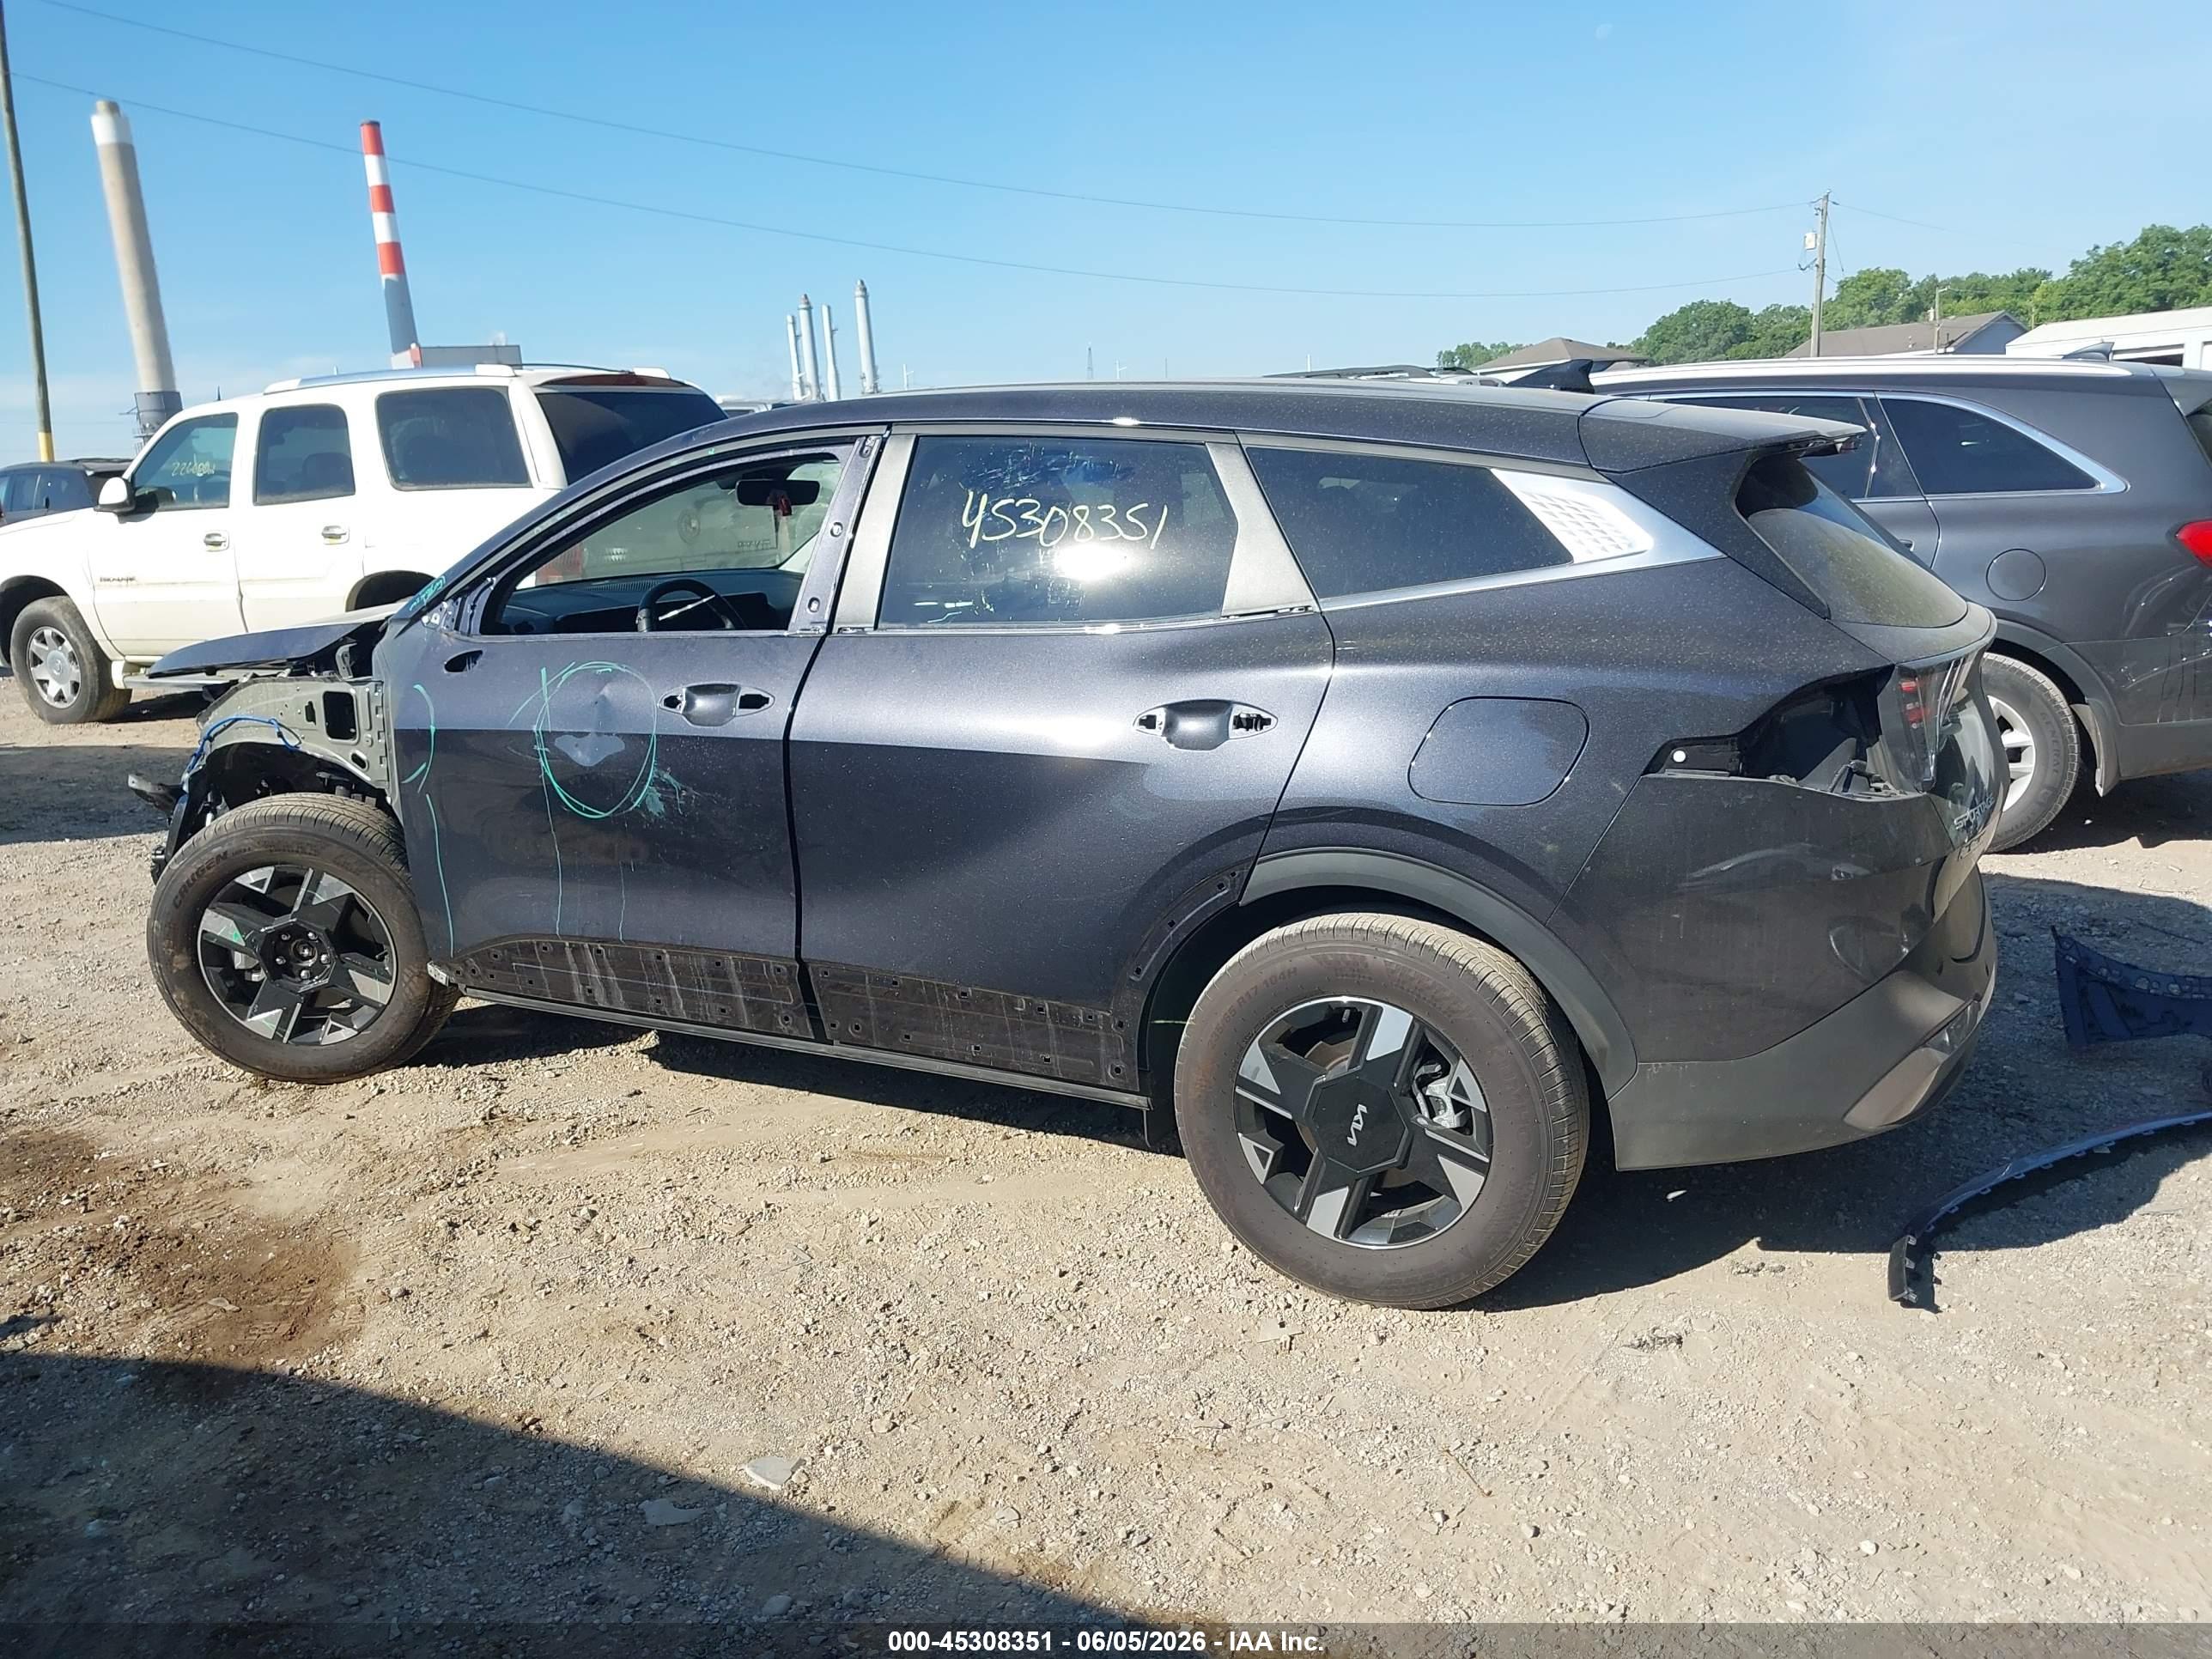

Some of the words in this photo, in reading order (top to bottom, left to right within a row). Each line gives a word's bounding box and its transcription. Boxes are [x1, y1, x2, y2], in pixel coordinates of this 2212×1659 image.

[962, 490, 1168, 550] 45308351
[1237, 984, 1259, 1008] R17
[1261, 966, 1298, 988] 104H
